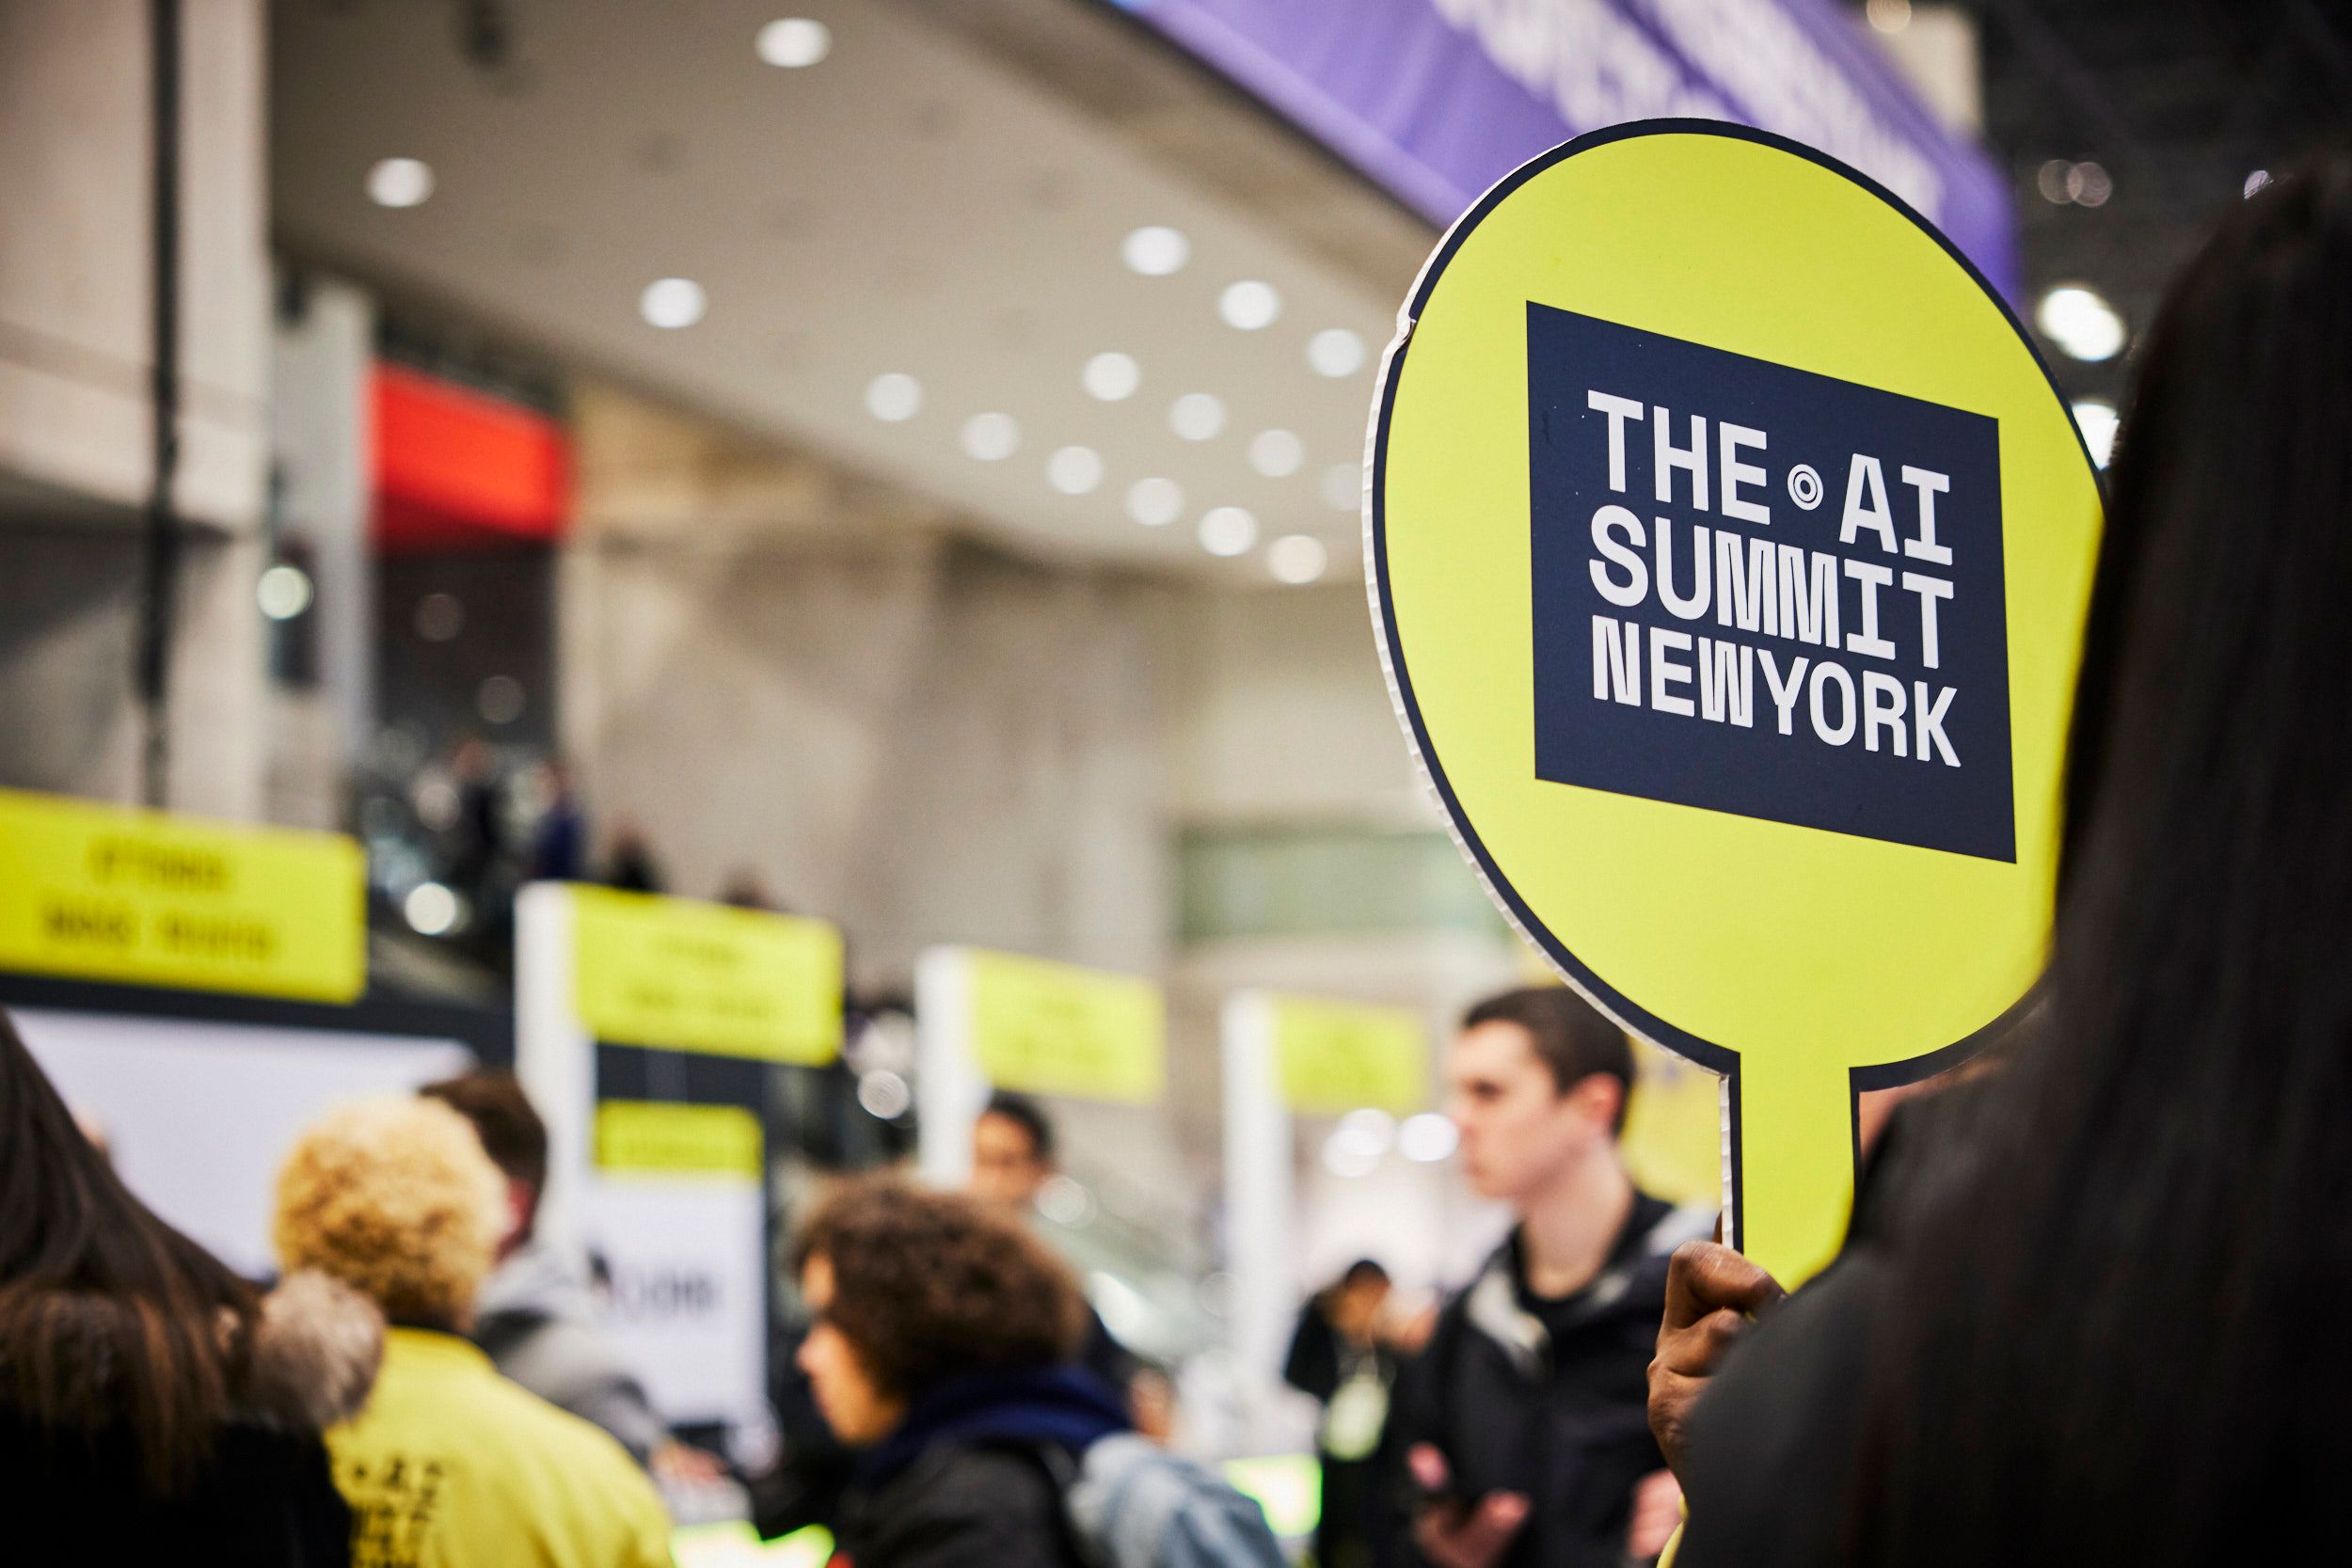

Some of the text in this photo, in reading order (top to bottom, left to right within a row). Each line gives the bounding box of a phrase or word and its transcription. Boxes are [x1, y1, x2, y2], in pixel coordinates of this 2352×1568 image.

[1587, 389, 1953, 566] THE AI
[1588, 504, 1954, 670] SUMMIT
